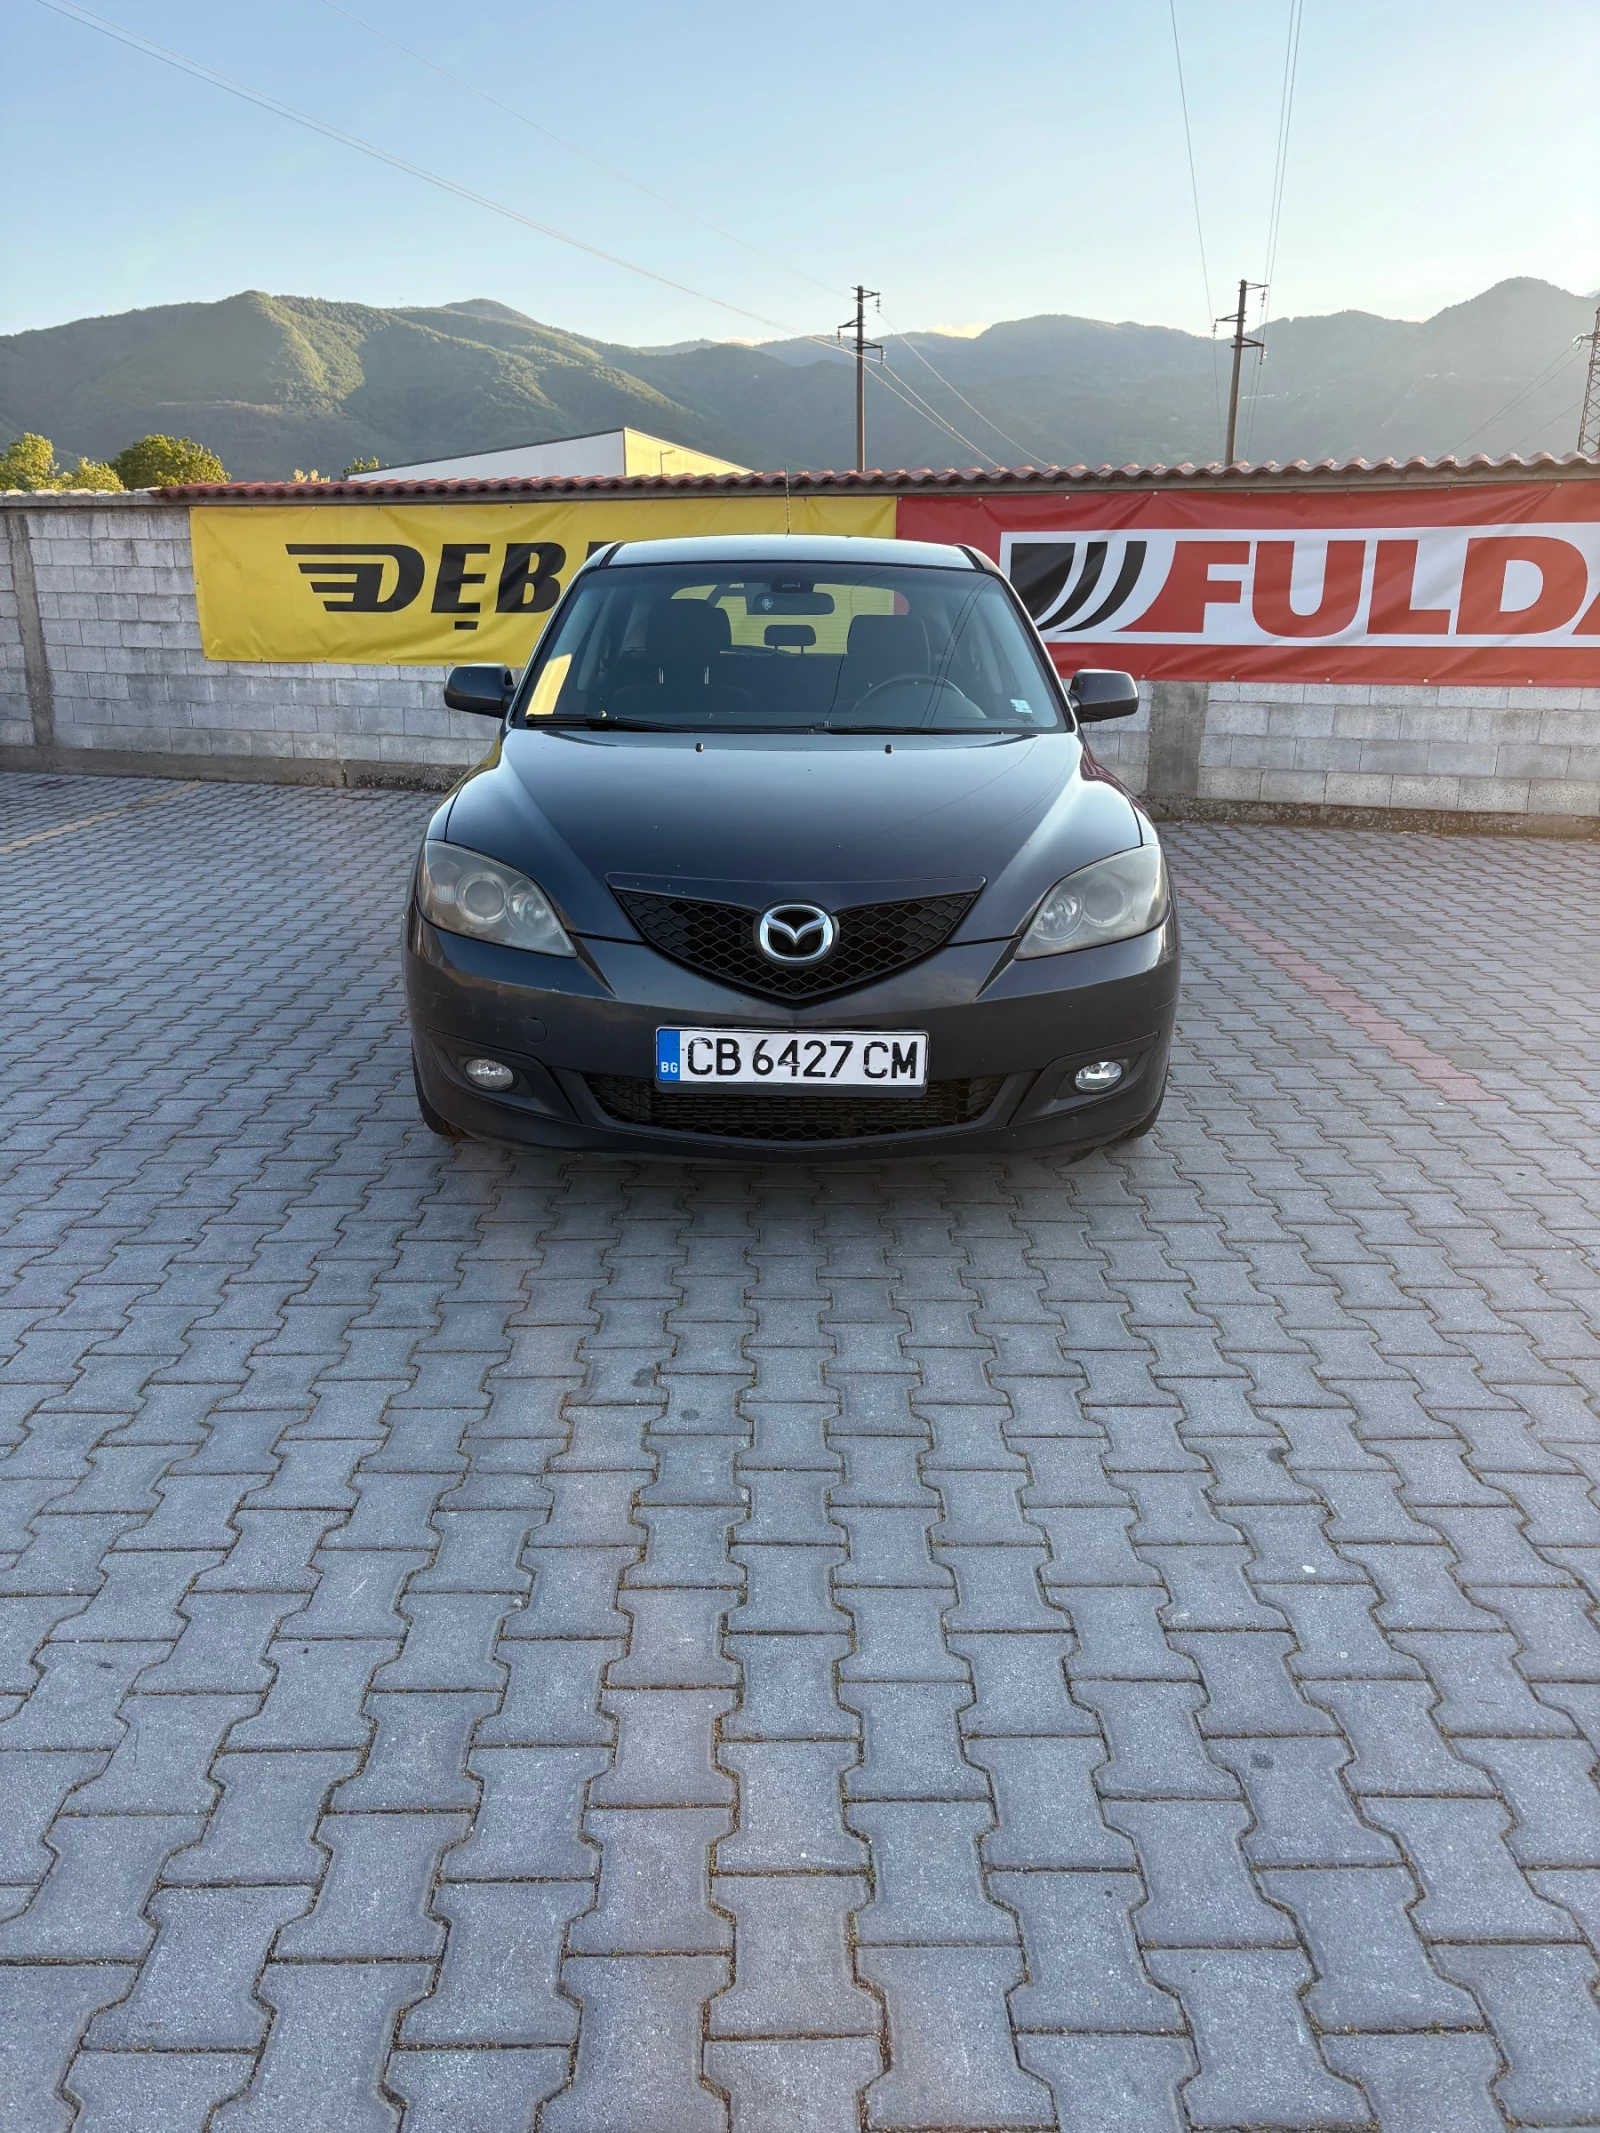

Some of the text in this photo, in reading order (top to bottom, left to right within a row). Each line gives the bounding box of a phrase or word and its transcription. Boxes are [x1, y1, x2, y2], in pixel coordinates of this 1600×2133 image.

[1111, 535, 1600, 638] FULD
[661, 1061, 678, 1074] BG
[687, 1037, 918, 1079] CB 6427 CM
